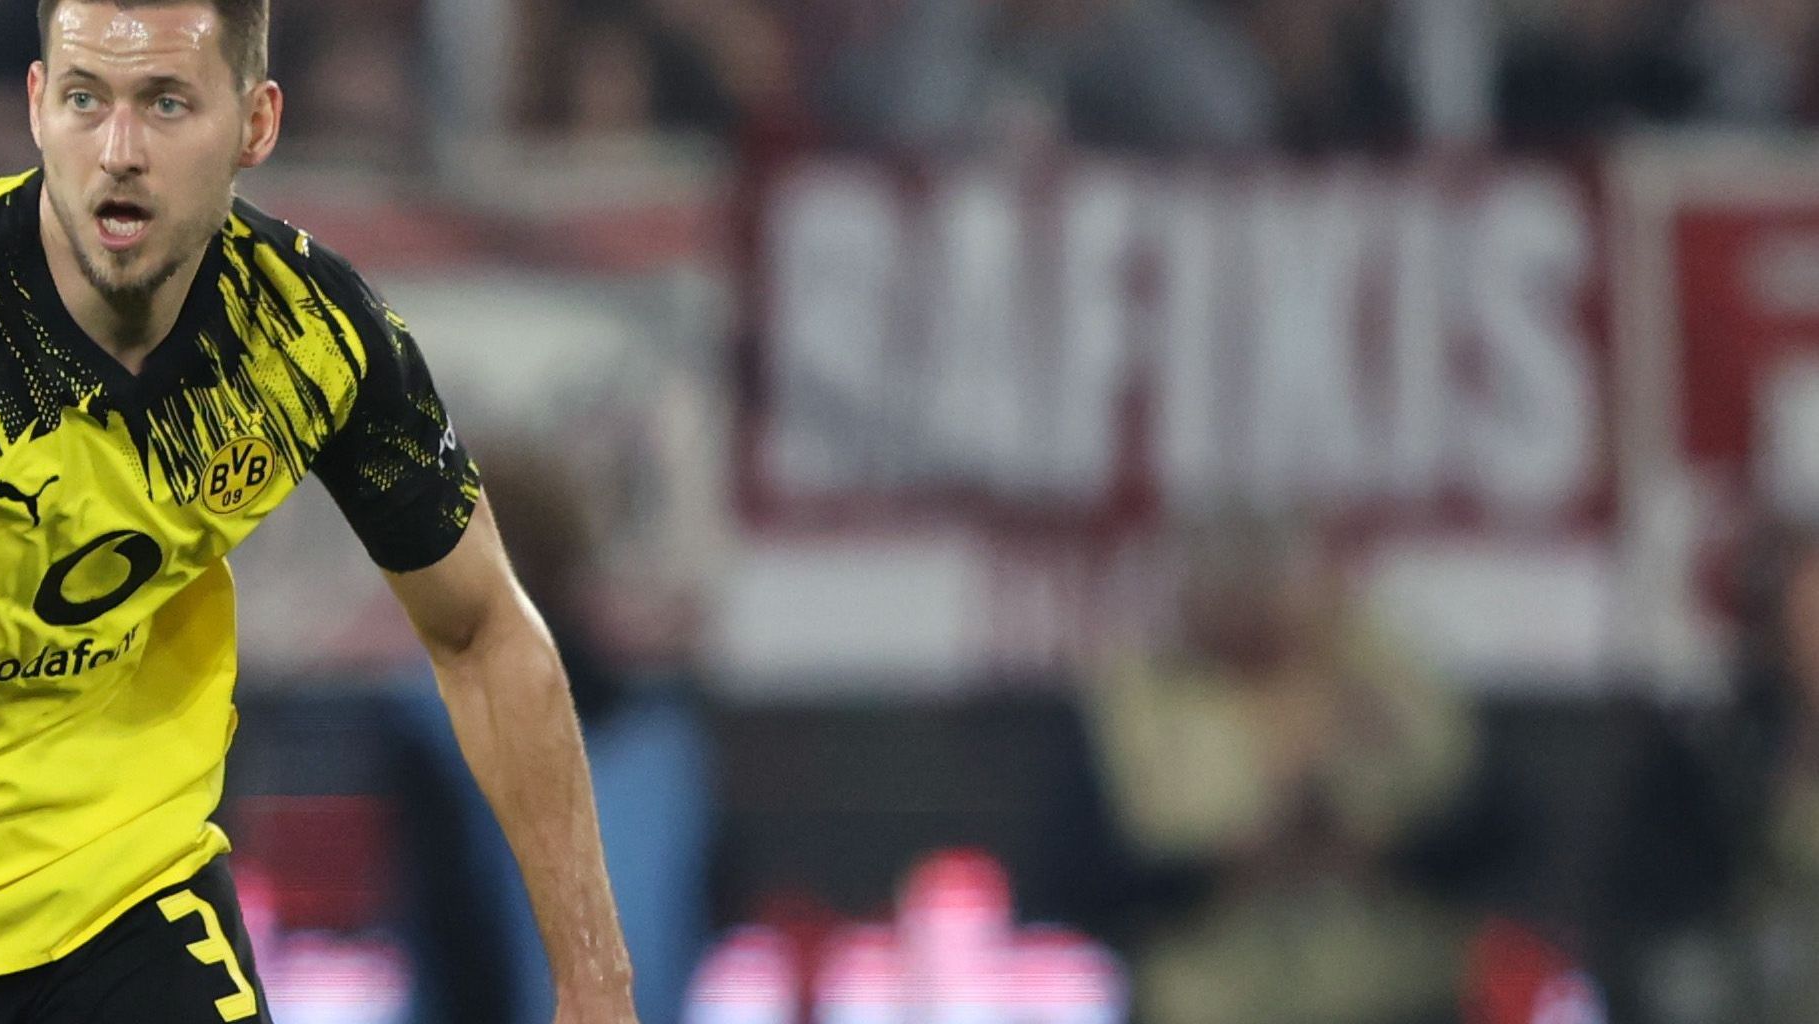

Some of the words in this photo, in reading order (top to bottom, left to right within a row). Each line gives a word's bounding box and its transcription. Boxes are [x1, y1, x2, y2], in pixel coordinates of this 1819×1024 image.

[210, 443, 267, 496] BVB
[222, 488, 242, 507] 09
[156, 889, 257, 1022] 3
